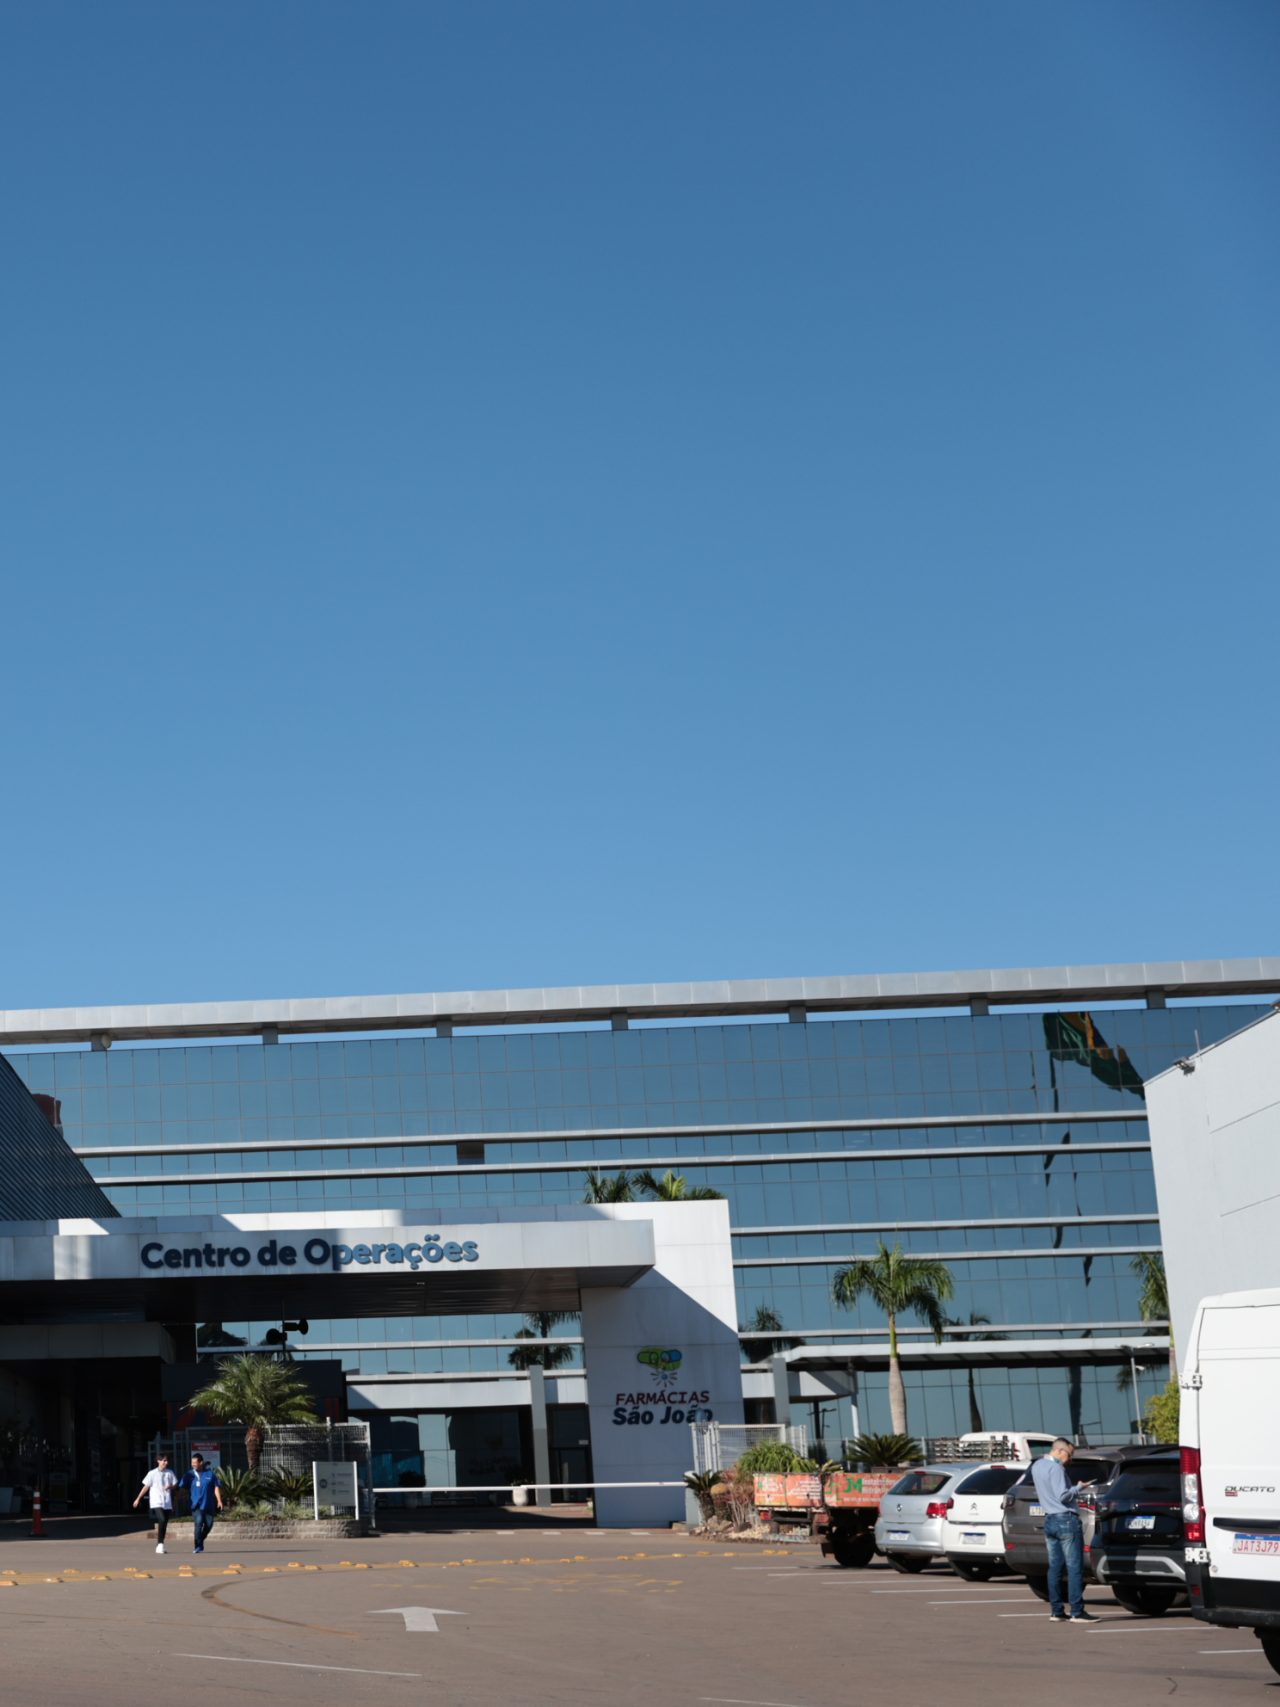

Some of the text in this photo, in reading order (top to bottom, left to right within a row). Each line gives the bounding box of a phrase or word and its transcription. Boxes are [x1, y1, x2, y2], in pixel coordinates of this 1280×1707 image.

[141, 1234, 480, 1271] Centro de Operações
[615, 1390, 710, 1405] FARMÁCIAS
[612, 1406, 654, 1425] São
